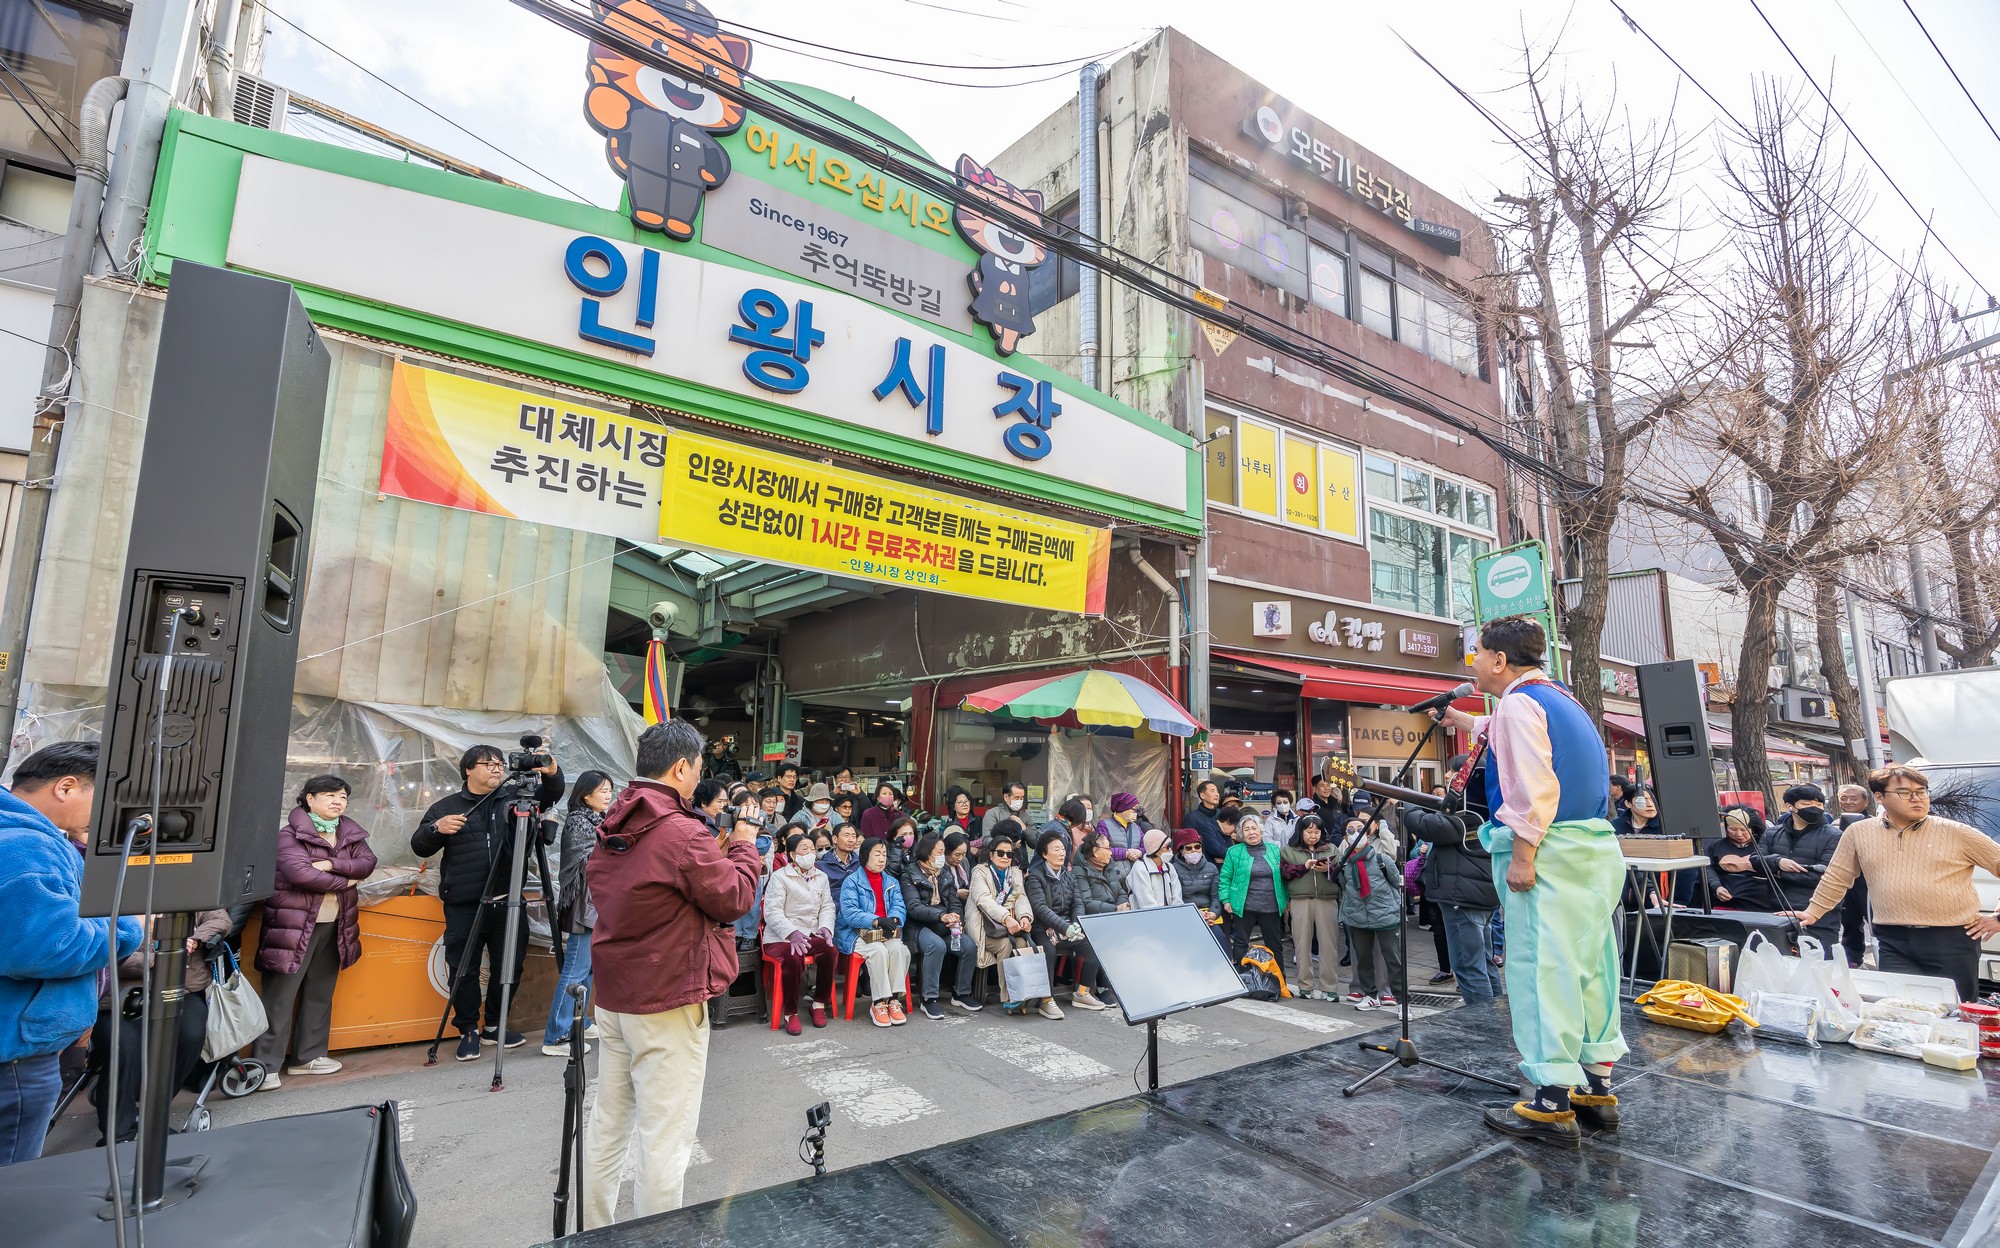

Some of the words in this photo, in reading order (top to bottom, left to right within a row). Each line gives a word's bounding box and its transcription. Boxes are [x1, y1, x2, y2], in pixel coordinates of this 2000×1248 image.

[746, 124, 951, 236] 어서오십시오
[1291, 126, 1352, 188] 오뚜기
[1355, 164, 1412, 222] 당구장
[1419, 223, 1458, 239] 394-5696
[800, 242, 941, 317] 추억뚝방길
[564, 235, 1063, 461] 인왕시장
[490, 445, 647, 509] 추진하는
[688, 453, 820, 508] 인왕시장에서
[823, 485, 884, 522] 구매한
[886, 500, 992, 545] 고객분들께는
[995, 523, 1075, 562] 구매금액에
[1241, 457, 1272, 478] 나루터
[1296, 475, 1305, 493] 회
[718, 498, 805, 541] 상관없이
[811, 517, 861, 552] 1시간
[865, 530, 975, 574] 무료주차권을
[978, 552, 1048, 587] 드립니다.
[1407, 642, 1437, 655] 3417-3377
[1198, 760, 1209, 769] 18
[1353, 728, 1390, 741] TAKE
